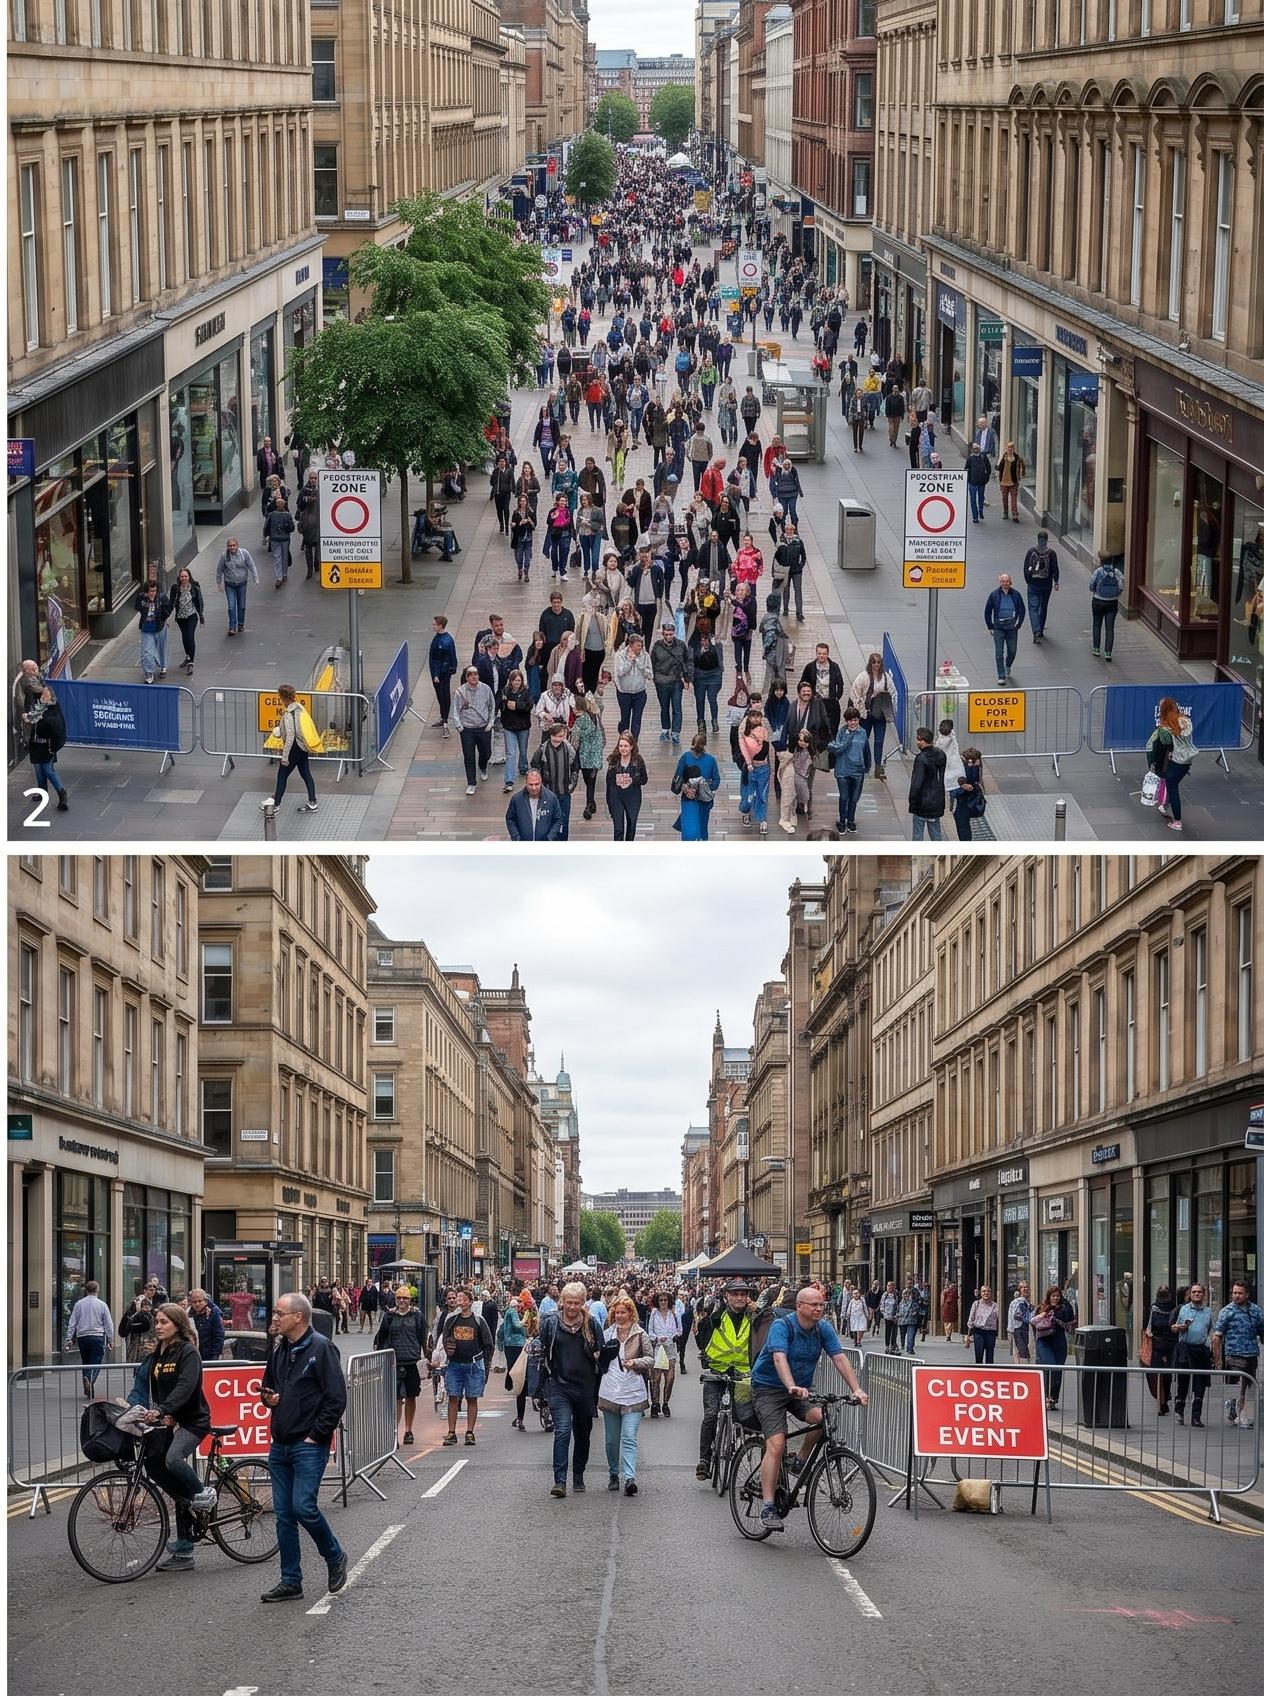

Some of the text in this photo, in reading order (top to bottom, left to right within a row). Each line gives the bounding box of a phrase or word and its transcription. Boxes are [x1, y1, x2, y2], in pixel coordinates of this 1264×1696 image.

[332, 483, 367, 493] ZONE
[919, 483, 954, 493] ZONE
[974, 697, 1019, 706] CLOSED
[986, 708, 1008, 717] FOR
[979, 719, 1015, 728] EVENT
[214, 1378, 263, 1398] CLO
[927, 1378, 1029, 1400] CLOSED
[239, 1401, 272, 1420] FO
[954, 1403, 1004, 1423] FOR
[223, 1425, 273, 1446] EVE
[939, 1426, 1021, 1448] EVENT
